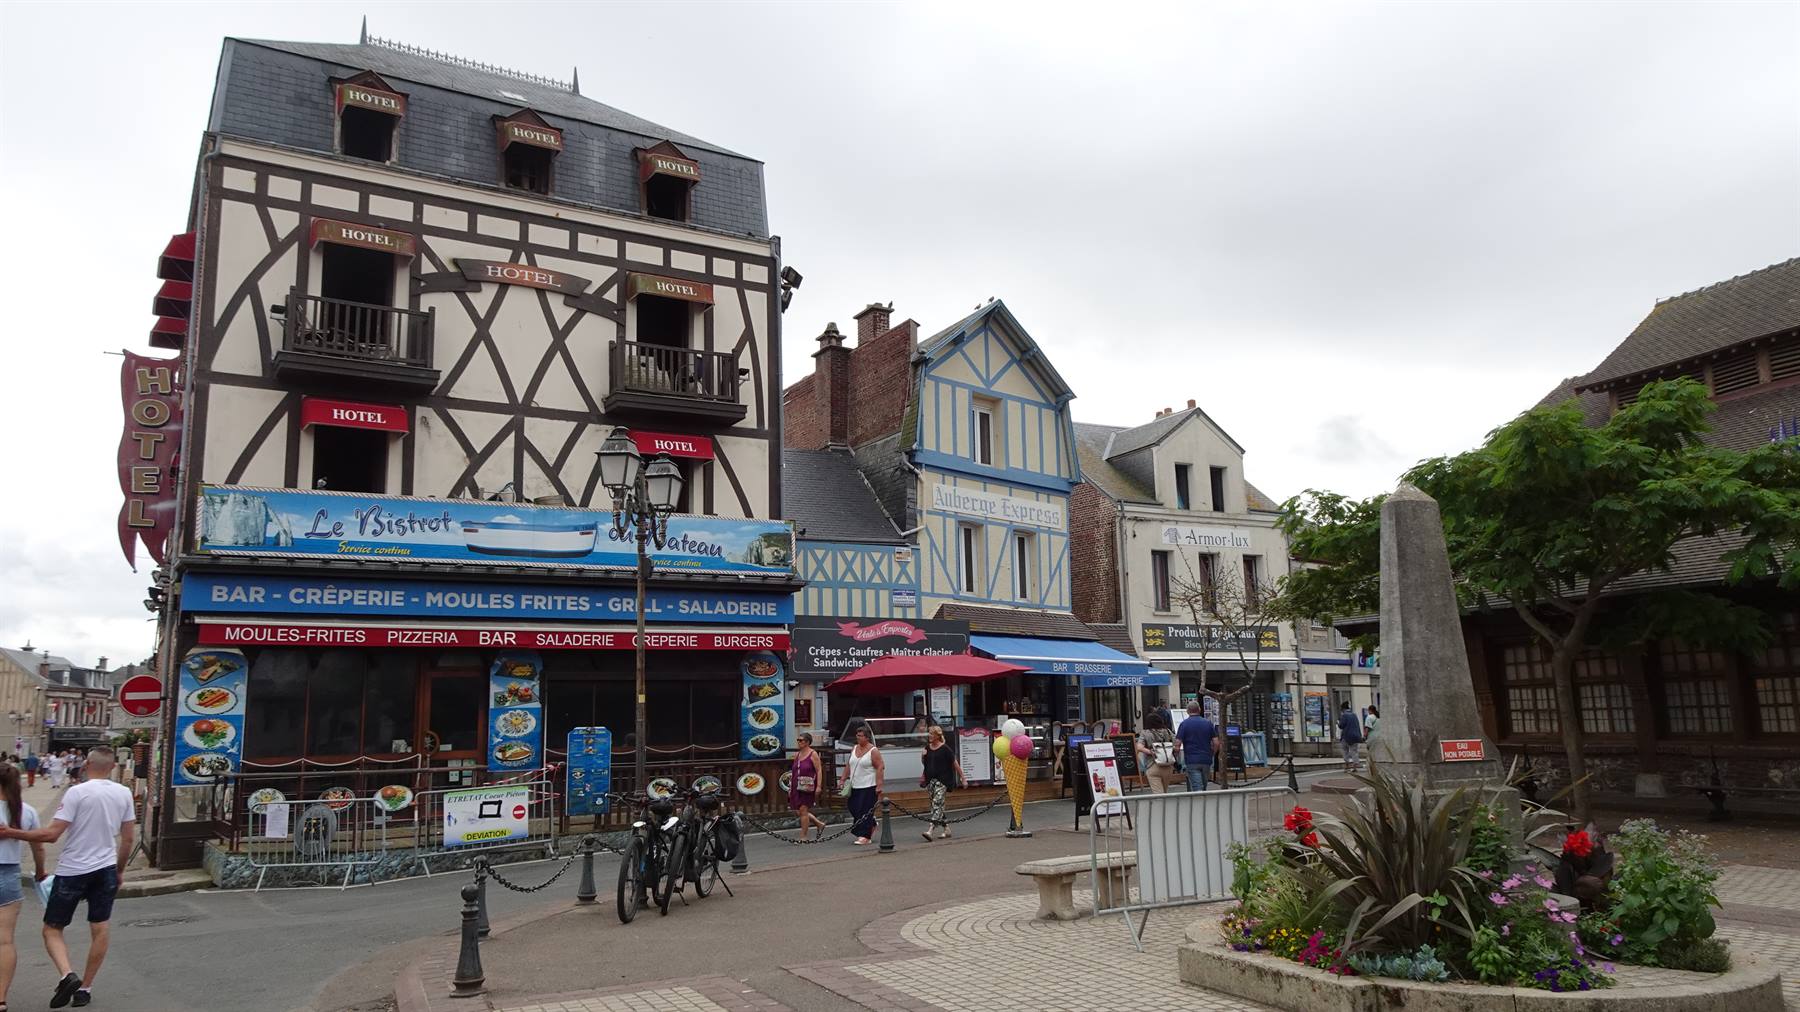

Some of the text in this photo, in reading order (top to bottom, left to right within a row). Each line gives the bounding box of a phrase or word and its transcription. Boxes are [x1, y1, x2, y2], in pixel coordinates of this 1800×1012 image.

[348, 90, 400, 110] HOTEL
[513, 127, 559, 147] HOTEL
[657, 159, 698, 176] HOTEL
[341, 228, 394, 247] HOTEL
[486, 265, 561, 288] HOTEL
[656, 281, 697, 297] HOTEL
[332, 408, 387, 424] HOTEL
[128, 367, 172, 527] HOTEL
[655, 440, 697, 453] HOTEL
[935, 486, 1060, 526] Auberge Express
[305, 504, 451, 538] Le Bistrot
[337, 540, 411, 555] Service continu
[211, 585, 777, 616] BAR CRÊPERIE MOULES FRITES GRL SALADERIE
[225, 627, 366, 643] MOULES-FRITES
[388, 631, 458, 644] PIZZERIA
[479, 632, 516, 645] BAR
[536, 634, 614, 646] SALADERIE
[714, 636, 774, 648] BURGERS
[1211, 627, 1256, 640] Régioaux
[809, 646, 953, 658] Crêpes Gaufres Maître Glacier
[814, 657, 863, 668] Sandwichs
[1053, 663, 1112, 674] BAR BRASSERIE
[1459, 750, 1482, 758] POTABLE
[448, 795, 483, 803] ETRETAT
[466, 830, 507, 840] DEVIATION
